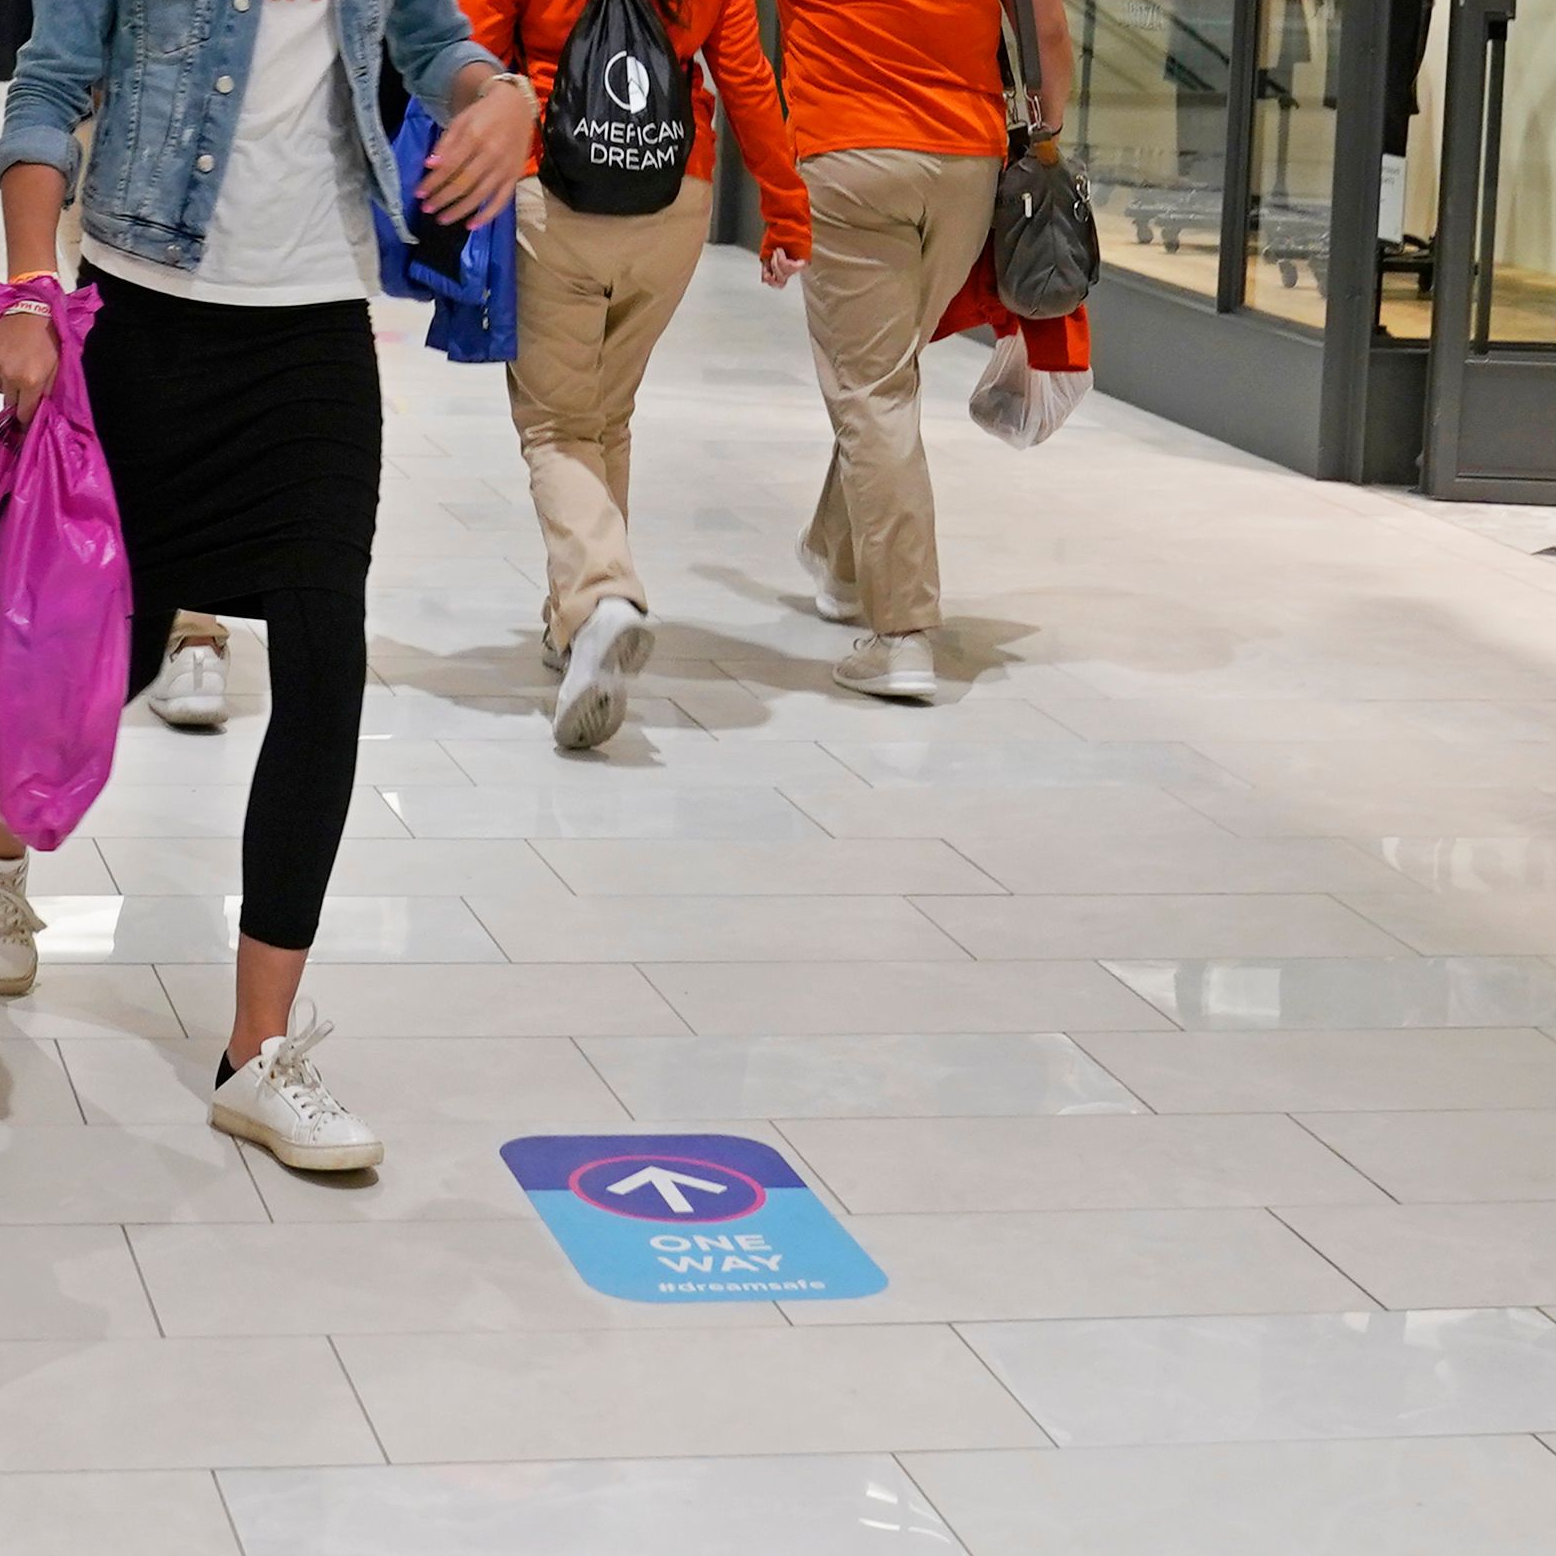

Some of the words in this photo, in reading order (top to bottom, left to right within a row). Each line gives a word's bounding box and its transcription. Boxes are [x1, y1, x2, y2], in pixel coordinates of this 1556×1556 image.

[573, 117, 684, 146] AMERICAN
[590, 143, 675, 171] DREAM
[649, 1234, 773, 1253] ONE
[657, 1253, 783, 1273] WAY
[657, 1278, 827, 1293] #dreamsafe
